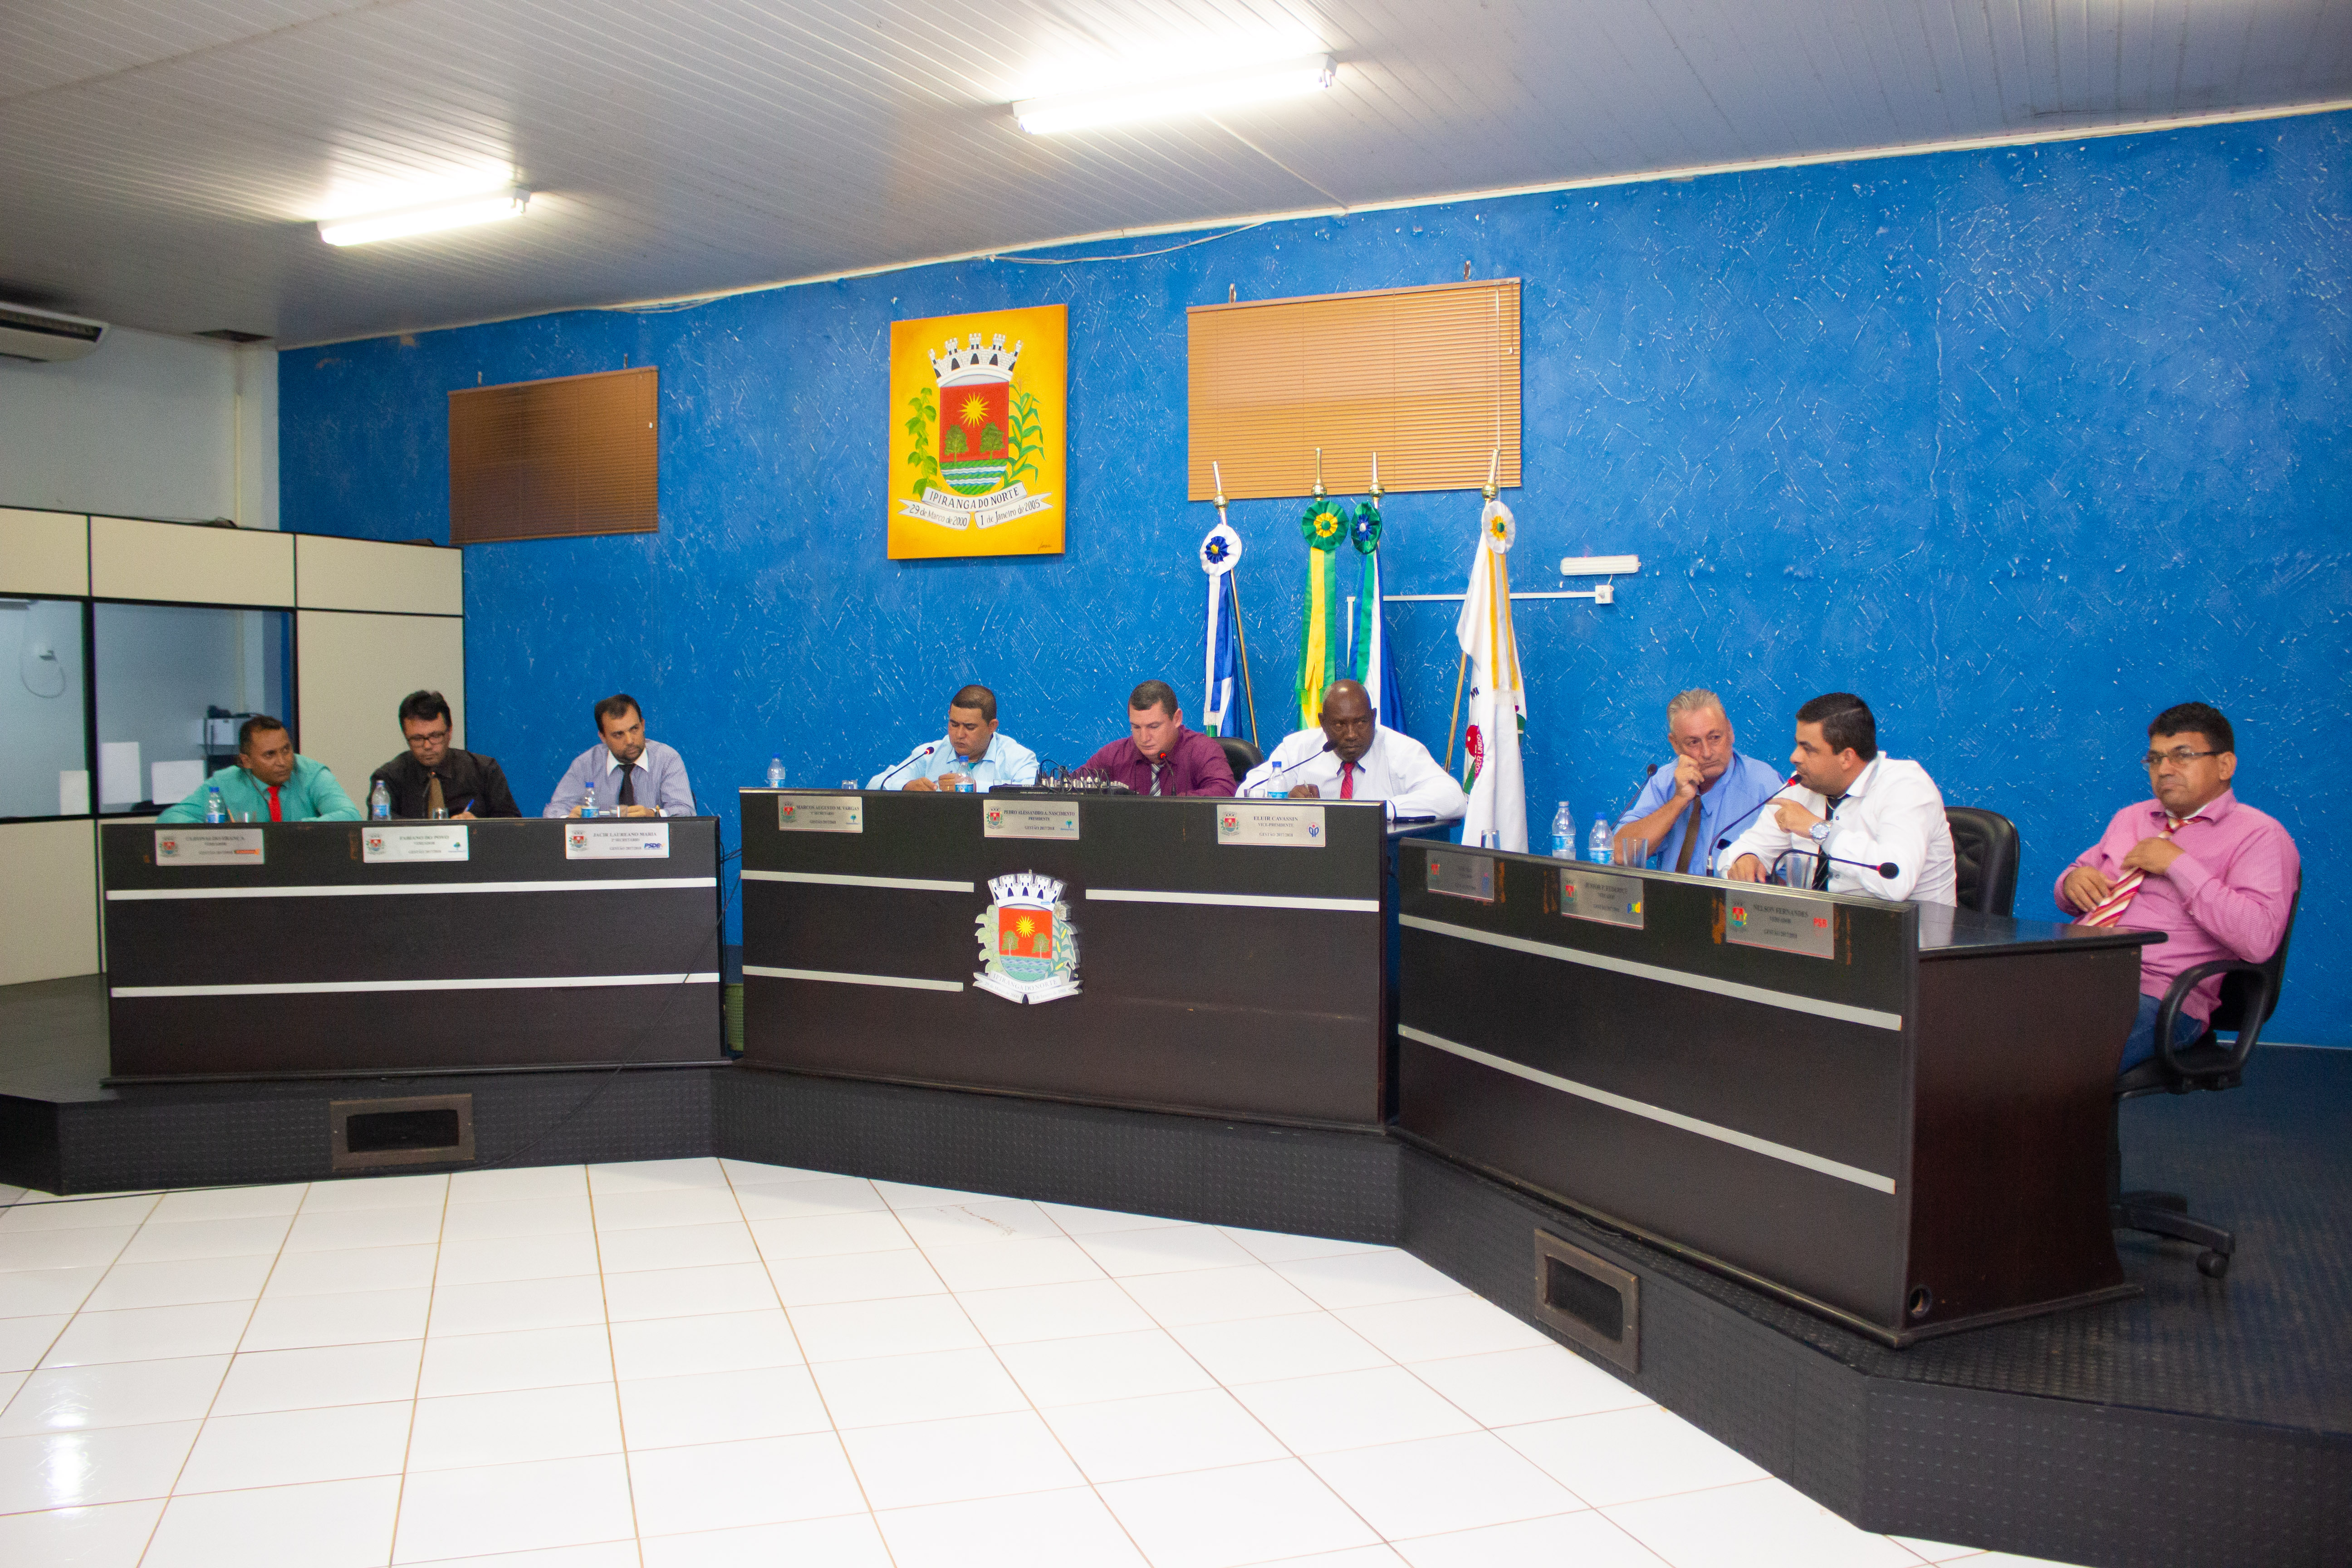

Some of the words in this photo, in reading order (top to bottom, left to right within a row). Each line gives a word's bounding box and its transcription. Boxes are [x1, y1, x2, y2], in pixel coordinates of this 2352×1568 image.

[929, 490, 976, 509] IPIRANGA
[979, 498, 989, 508] DO
[990, 487, 1019, 506] NORTE
[909, 504, 920, 514] 29
[920, 508, 927, 516] de
[946, 516, 952, 524] de
[953, 516, 967, 527] 2000
[980, 514, 984, 525] 1
[987, 515, 994, 524] de
[995, 509, 1016, 524] Janeiro
[1018, 505, 1024, 514] de
[1024, 499, 1040, 512] 2005
[1775, 907, 1809, 918] FERNANDES
[993, 973, 1023, 991] IPIRANGA
[1035, 980, 1057, 989] NORTE
